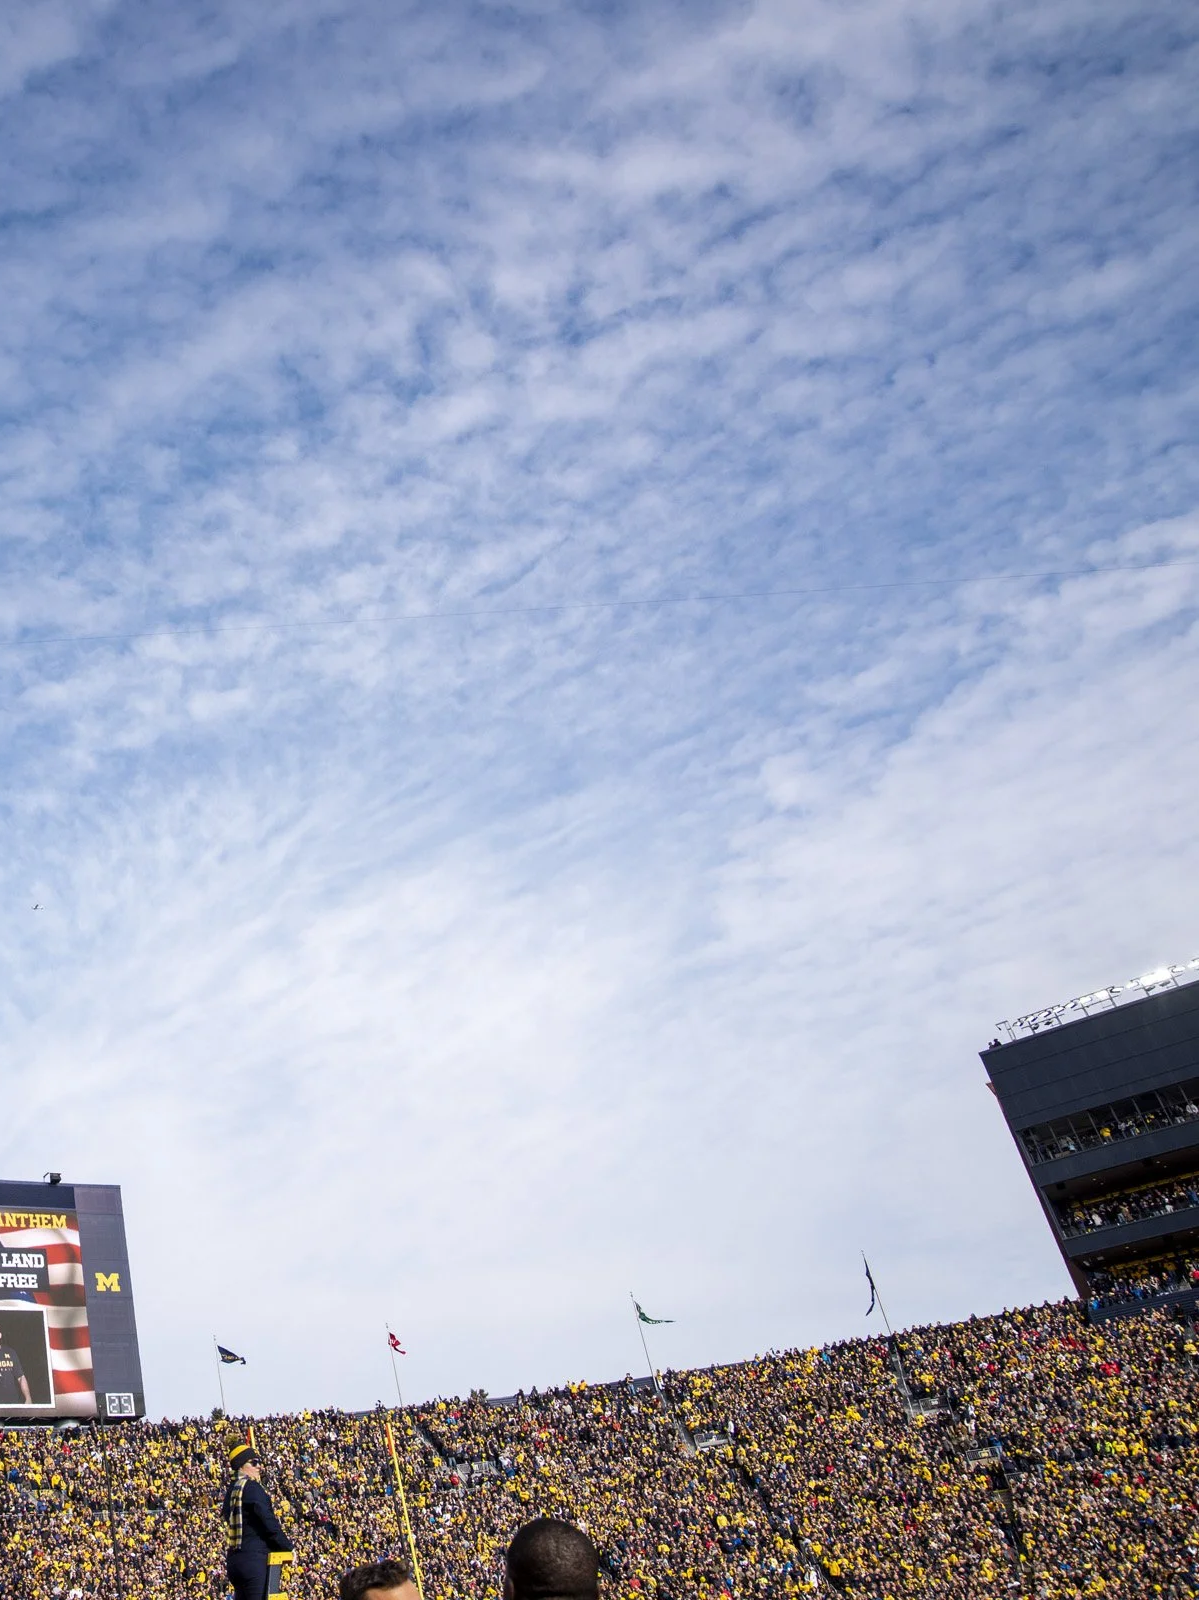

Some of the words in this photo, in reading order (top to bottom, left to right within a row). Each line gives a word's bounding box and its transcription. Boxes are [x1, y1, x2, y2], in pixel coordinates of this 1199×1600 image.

[1, 1253, 45, 1268] LAND
[95, 1272, 121, 1292] M
[110, 1396, 132, 1413] 25
